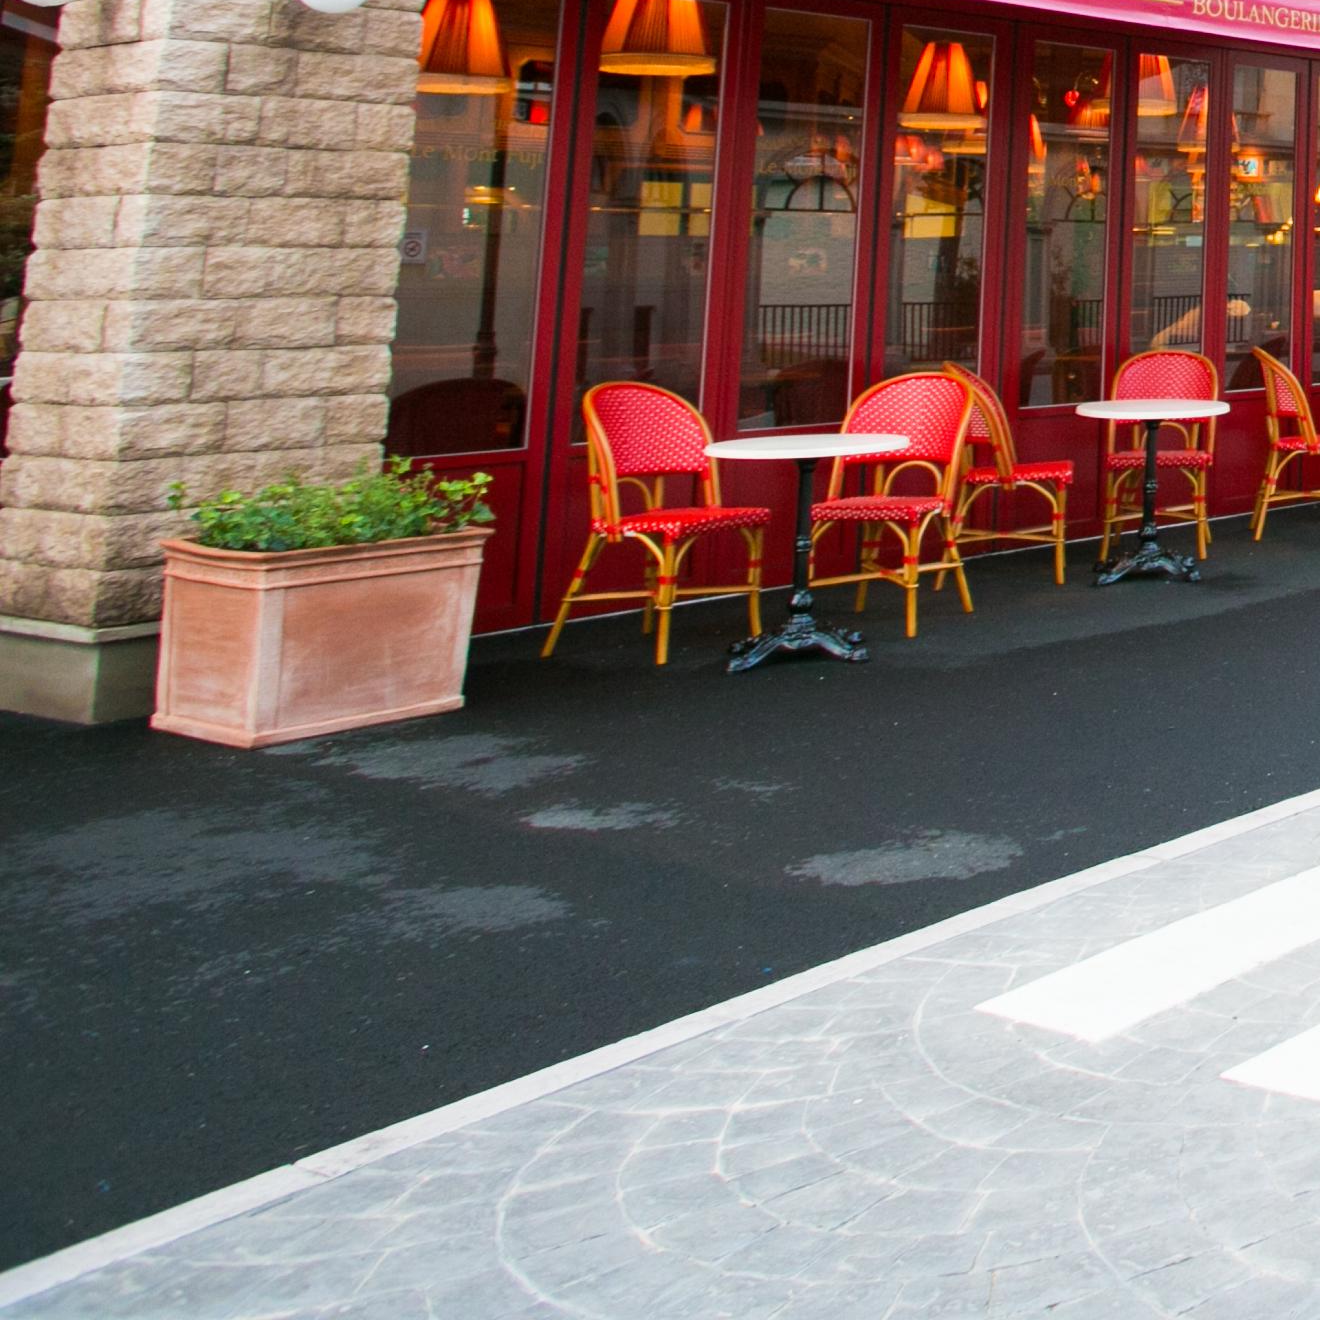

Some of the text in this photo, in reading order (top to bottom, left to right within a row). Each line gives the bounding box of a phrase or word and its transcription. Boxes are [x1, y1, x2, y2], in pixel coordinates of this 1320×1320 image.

[411, 145, 543, 170] Le Mont Fuji
